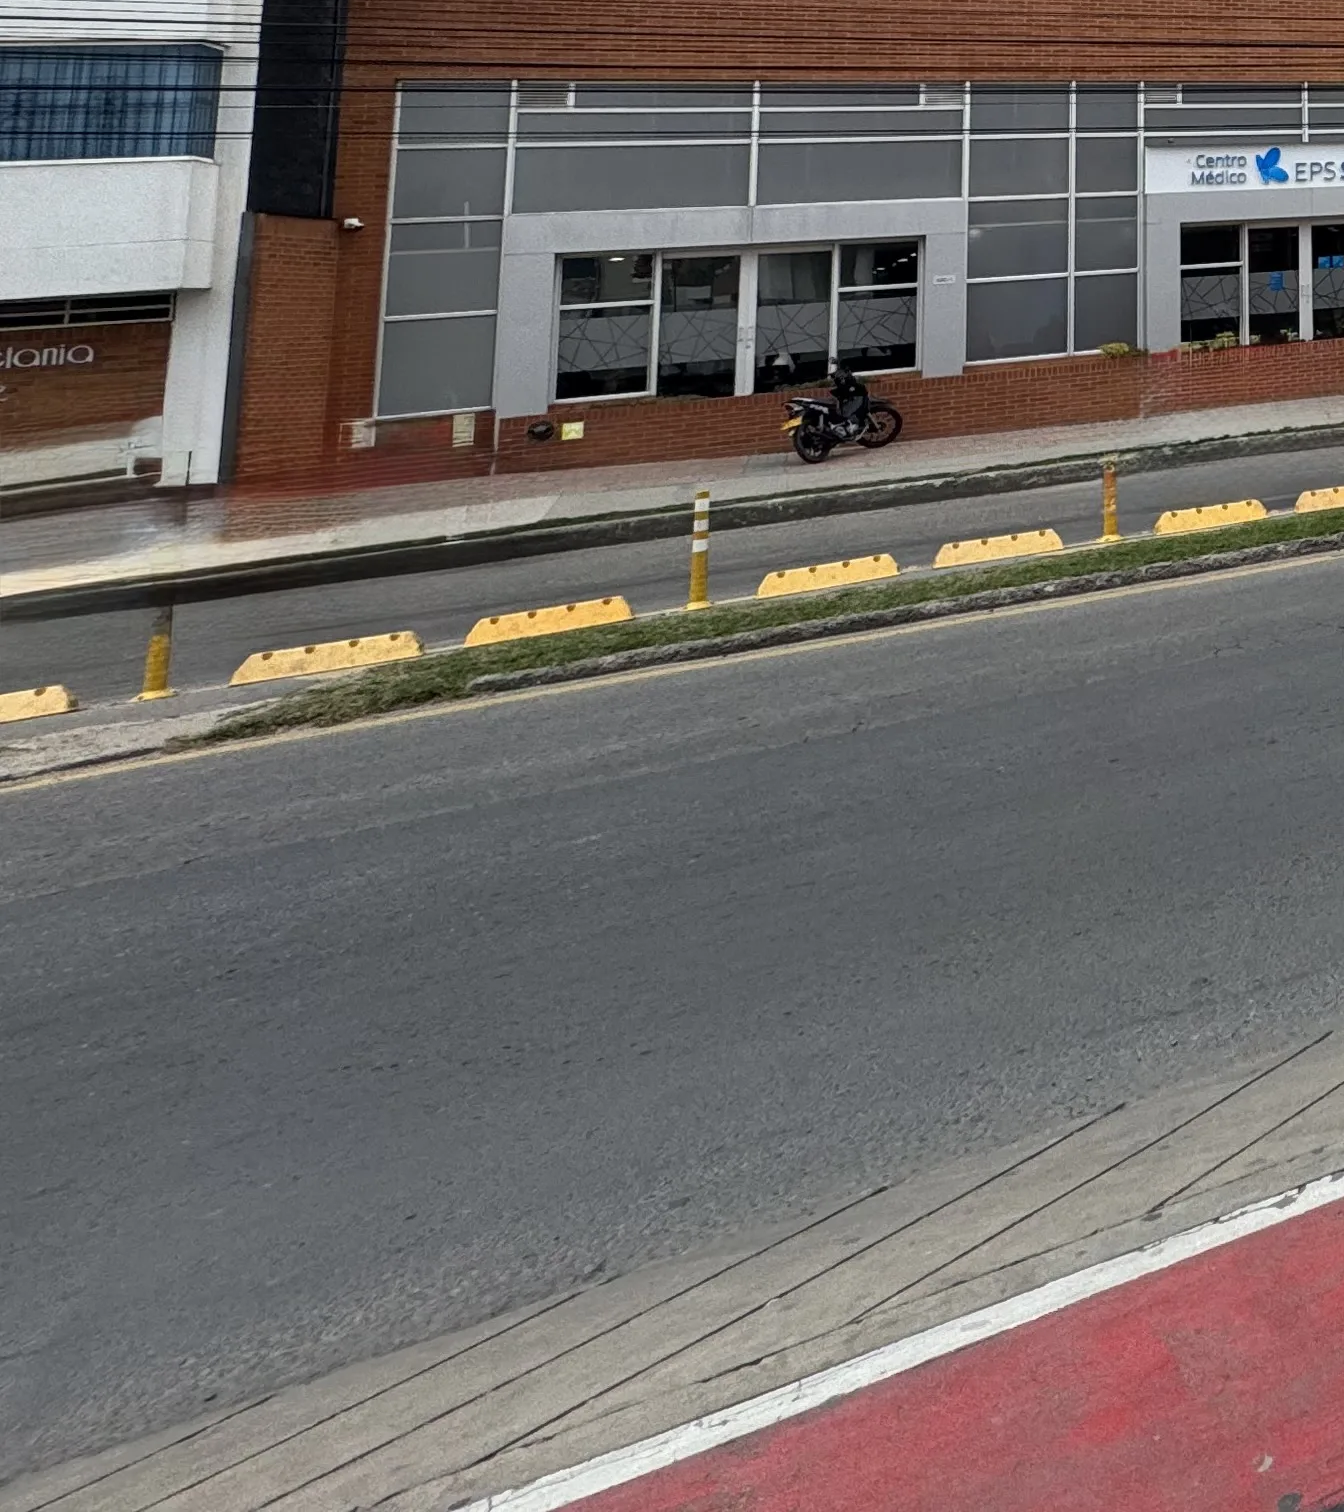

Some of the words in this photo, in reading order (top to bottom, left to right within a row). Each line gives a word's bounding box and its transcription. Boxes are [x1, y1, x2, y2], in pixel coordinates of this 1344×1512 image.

[1196, 154, 1247, 169] Centro
[1191, 170, 1247, 185] Médico
[1295, 162, 1336, 182] EPS
